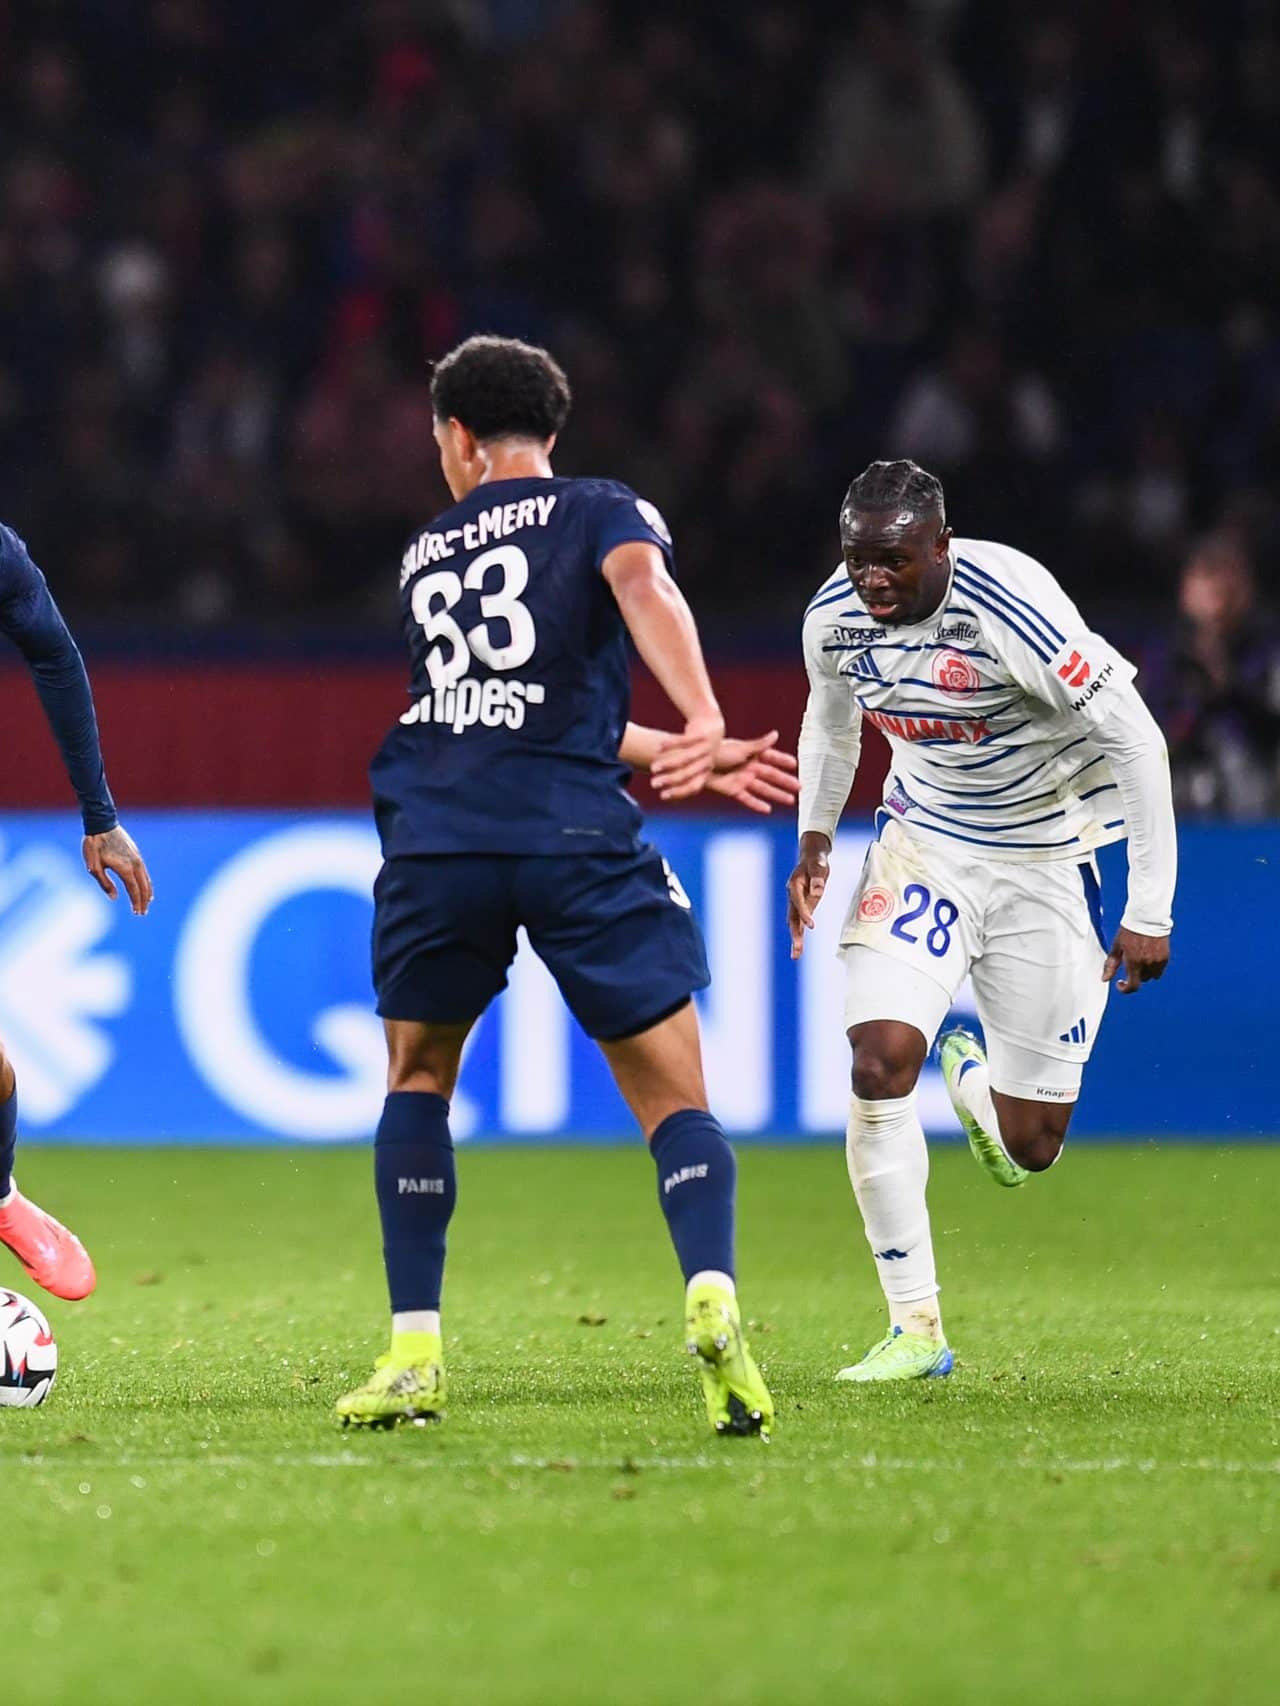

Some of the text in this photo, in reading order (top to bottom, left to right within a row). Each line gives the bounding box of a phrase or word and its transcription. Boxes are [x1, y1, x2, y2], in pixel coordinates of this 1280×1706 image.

[411, 545, 537, 690] 33
[1070, 664, 1114, 711] WÜRTH
[889, 883, 960, 958] 28
[398, 1178, 445, 1194] PARIS
[662, 1164, 708, 1193] PARIS
